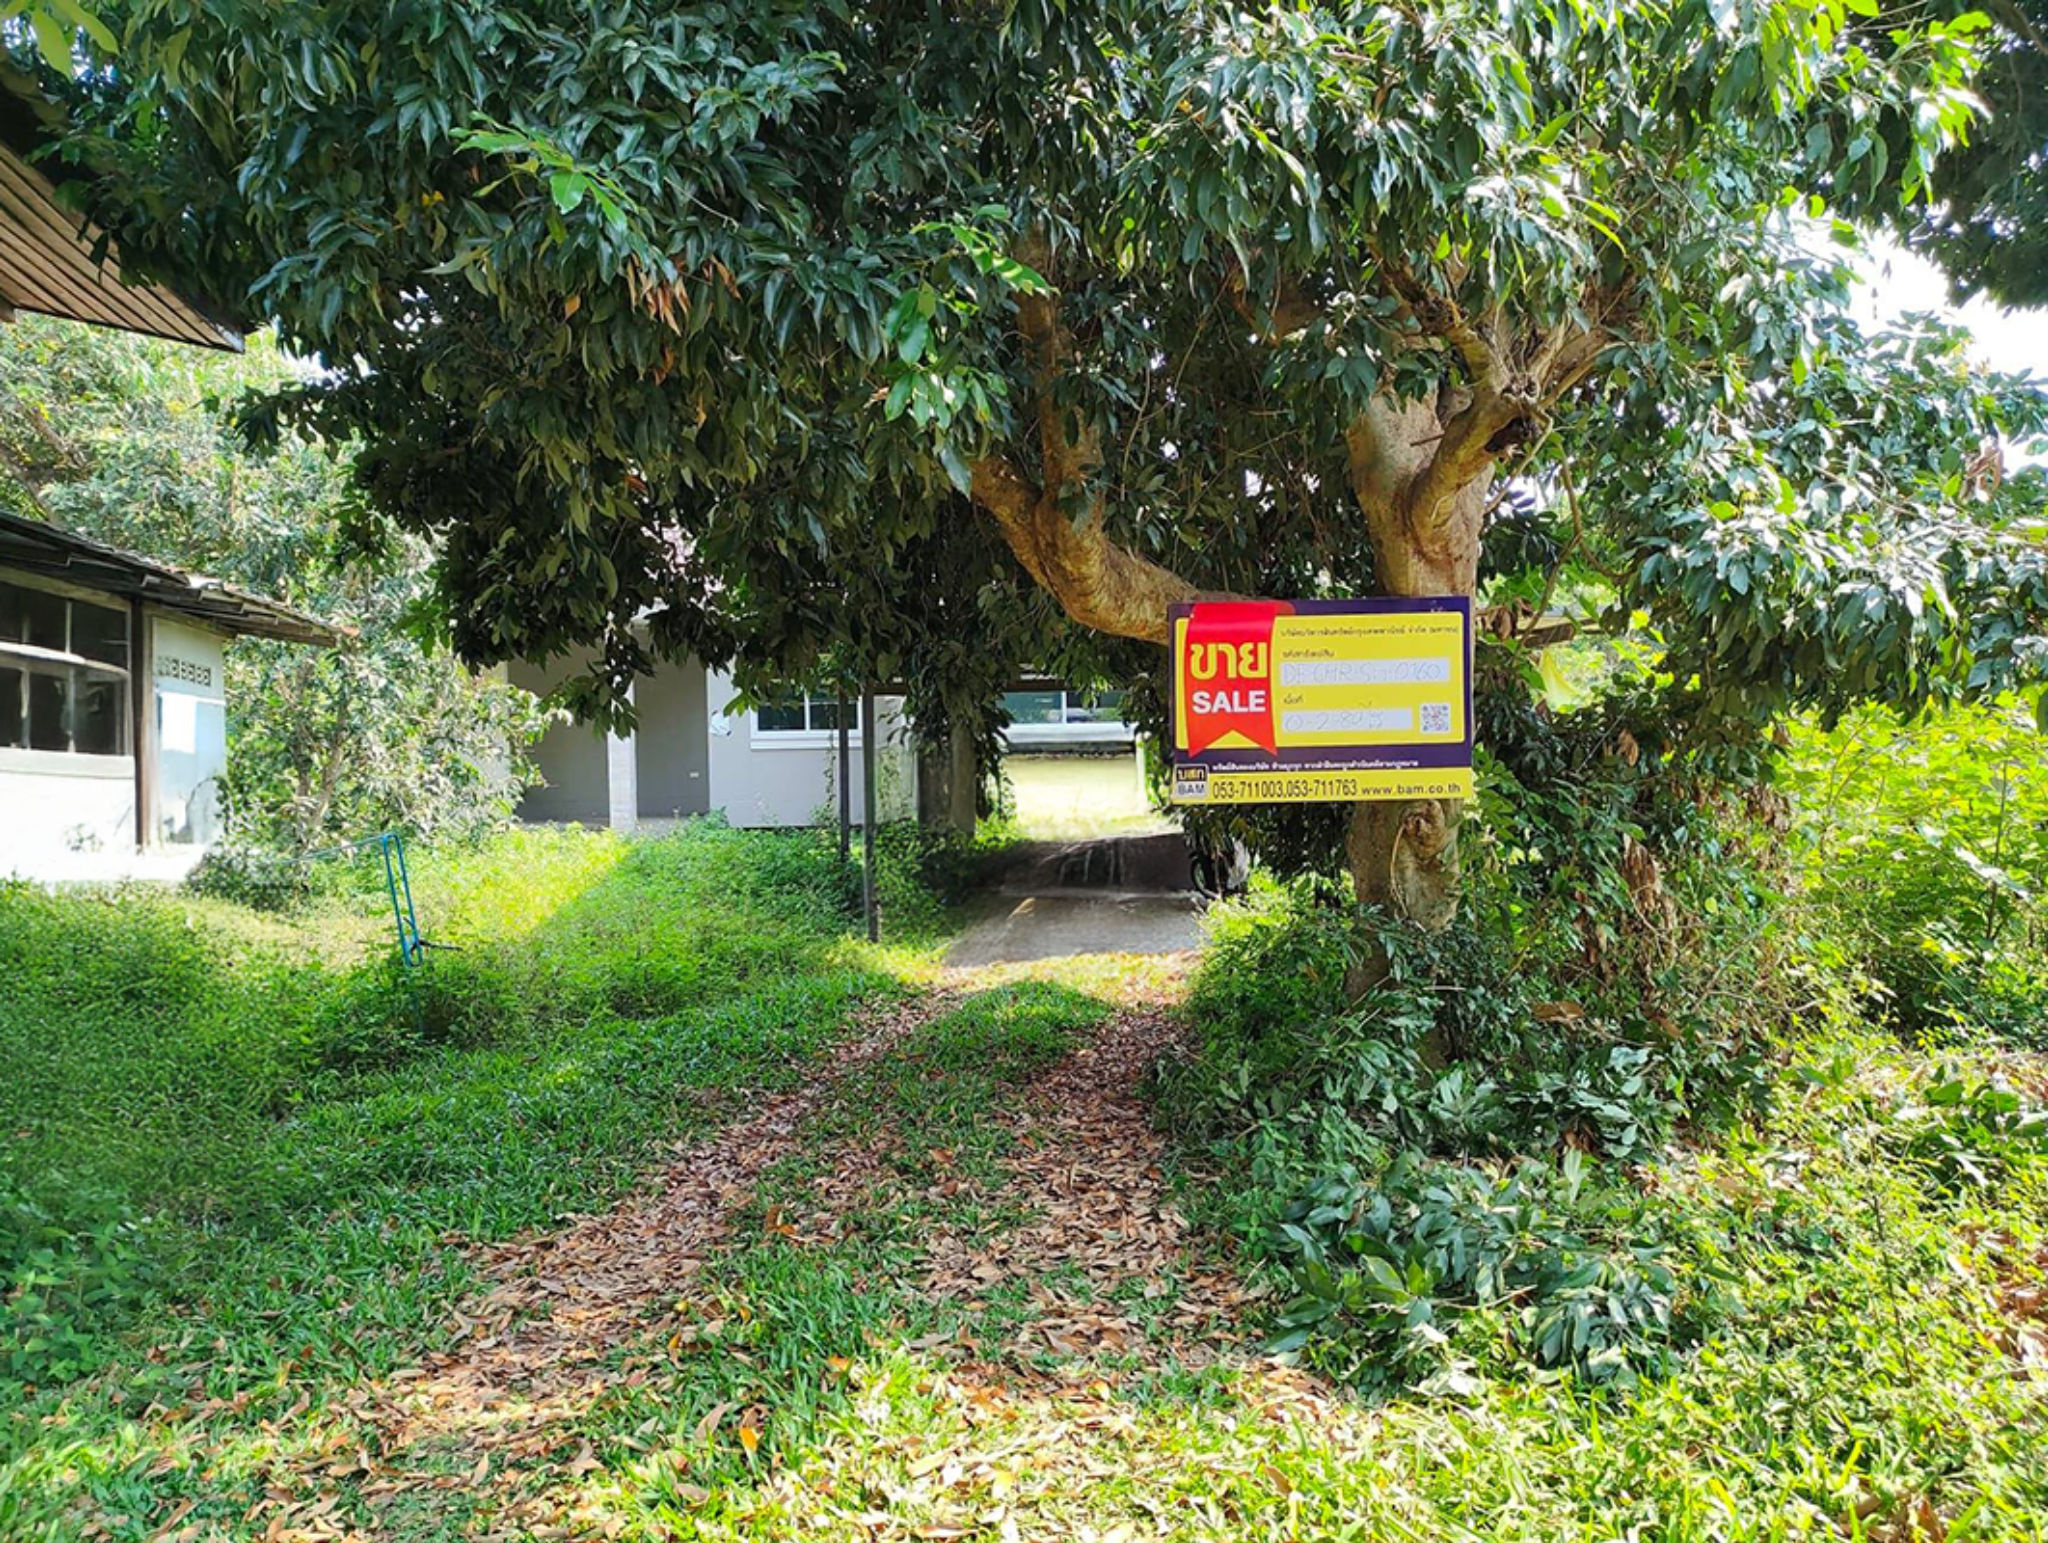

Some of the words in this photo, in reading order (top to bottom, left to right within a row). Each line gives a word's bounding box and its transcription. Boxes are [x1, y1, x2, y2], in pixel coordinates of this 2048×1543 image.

[1190, 641, 1268, 680] ขาย
[1192, 690, 1267, 714] SALE
[1178, 783, 1205, 795] BAM
